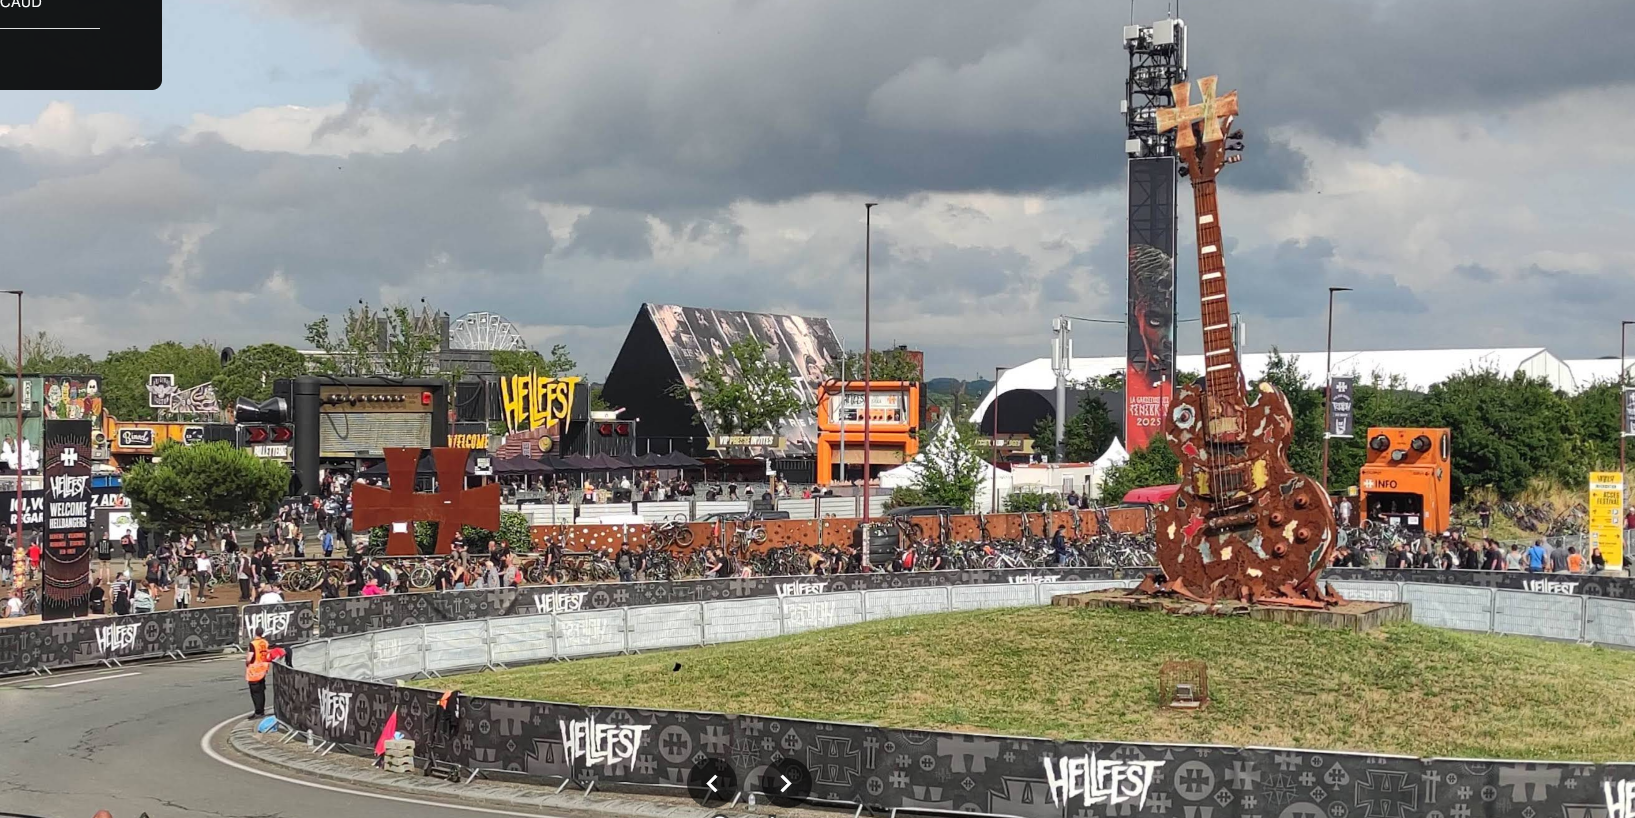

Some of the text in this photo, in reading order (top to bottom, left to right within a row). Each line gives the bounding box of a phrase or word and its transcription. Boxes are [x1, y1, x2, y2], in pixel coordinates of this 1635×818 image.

[500, 366, 581, 435] HELLFEST
[1137, 418, 1161, 427] 2025
[447, 433, 489, 449] WELCOME
[50, 474, 89, 499] HELLFEST
[1375, 480, 1397, 489] INFO
[50, 502, 87, 517] WELCOME
[534, 590, 588, 613] HELLFEST
[95, 622, 142, 654] HELLFEST
[245, 610, 294, 641] HELLFEST
[560, 714, 652, 773] HELLFEST
[1043, 750, 1166, 812] HELLFEST
